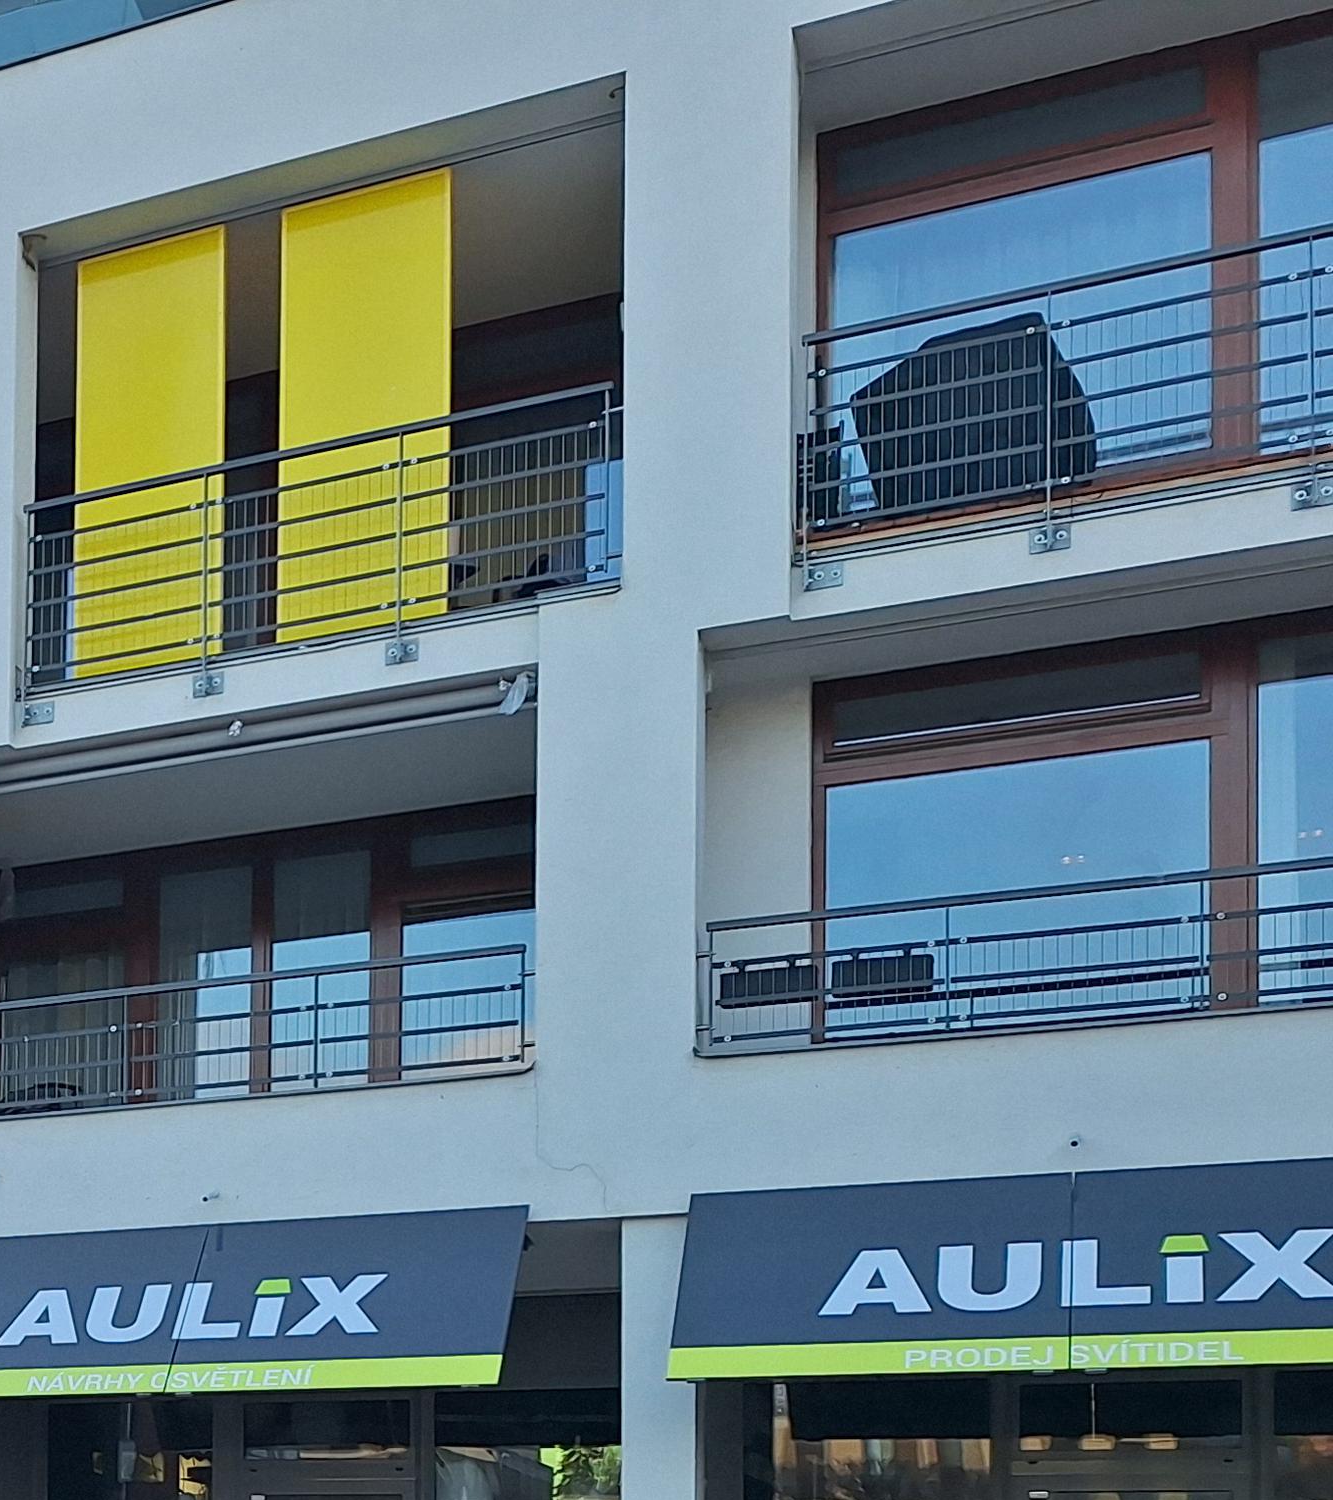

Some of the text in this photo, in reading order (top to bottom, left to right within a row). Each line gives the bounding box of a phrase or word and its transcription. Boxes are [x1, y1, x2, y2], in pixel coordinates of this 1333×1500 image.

[904, 1338, 1245, 1369] PRODEJ SVÍTIDEL
[27, 1364, 317, 1393] NÁVRHY OSVĚTLENÍ
